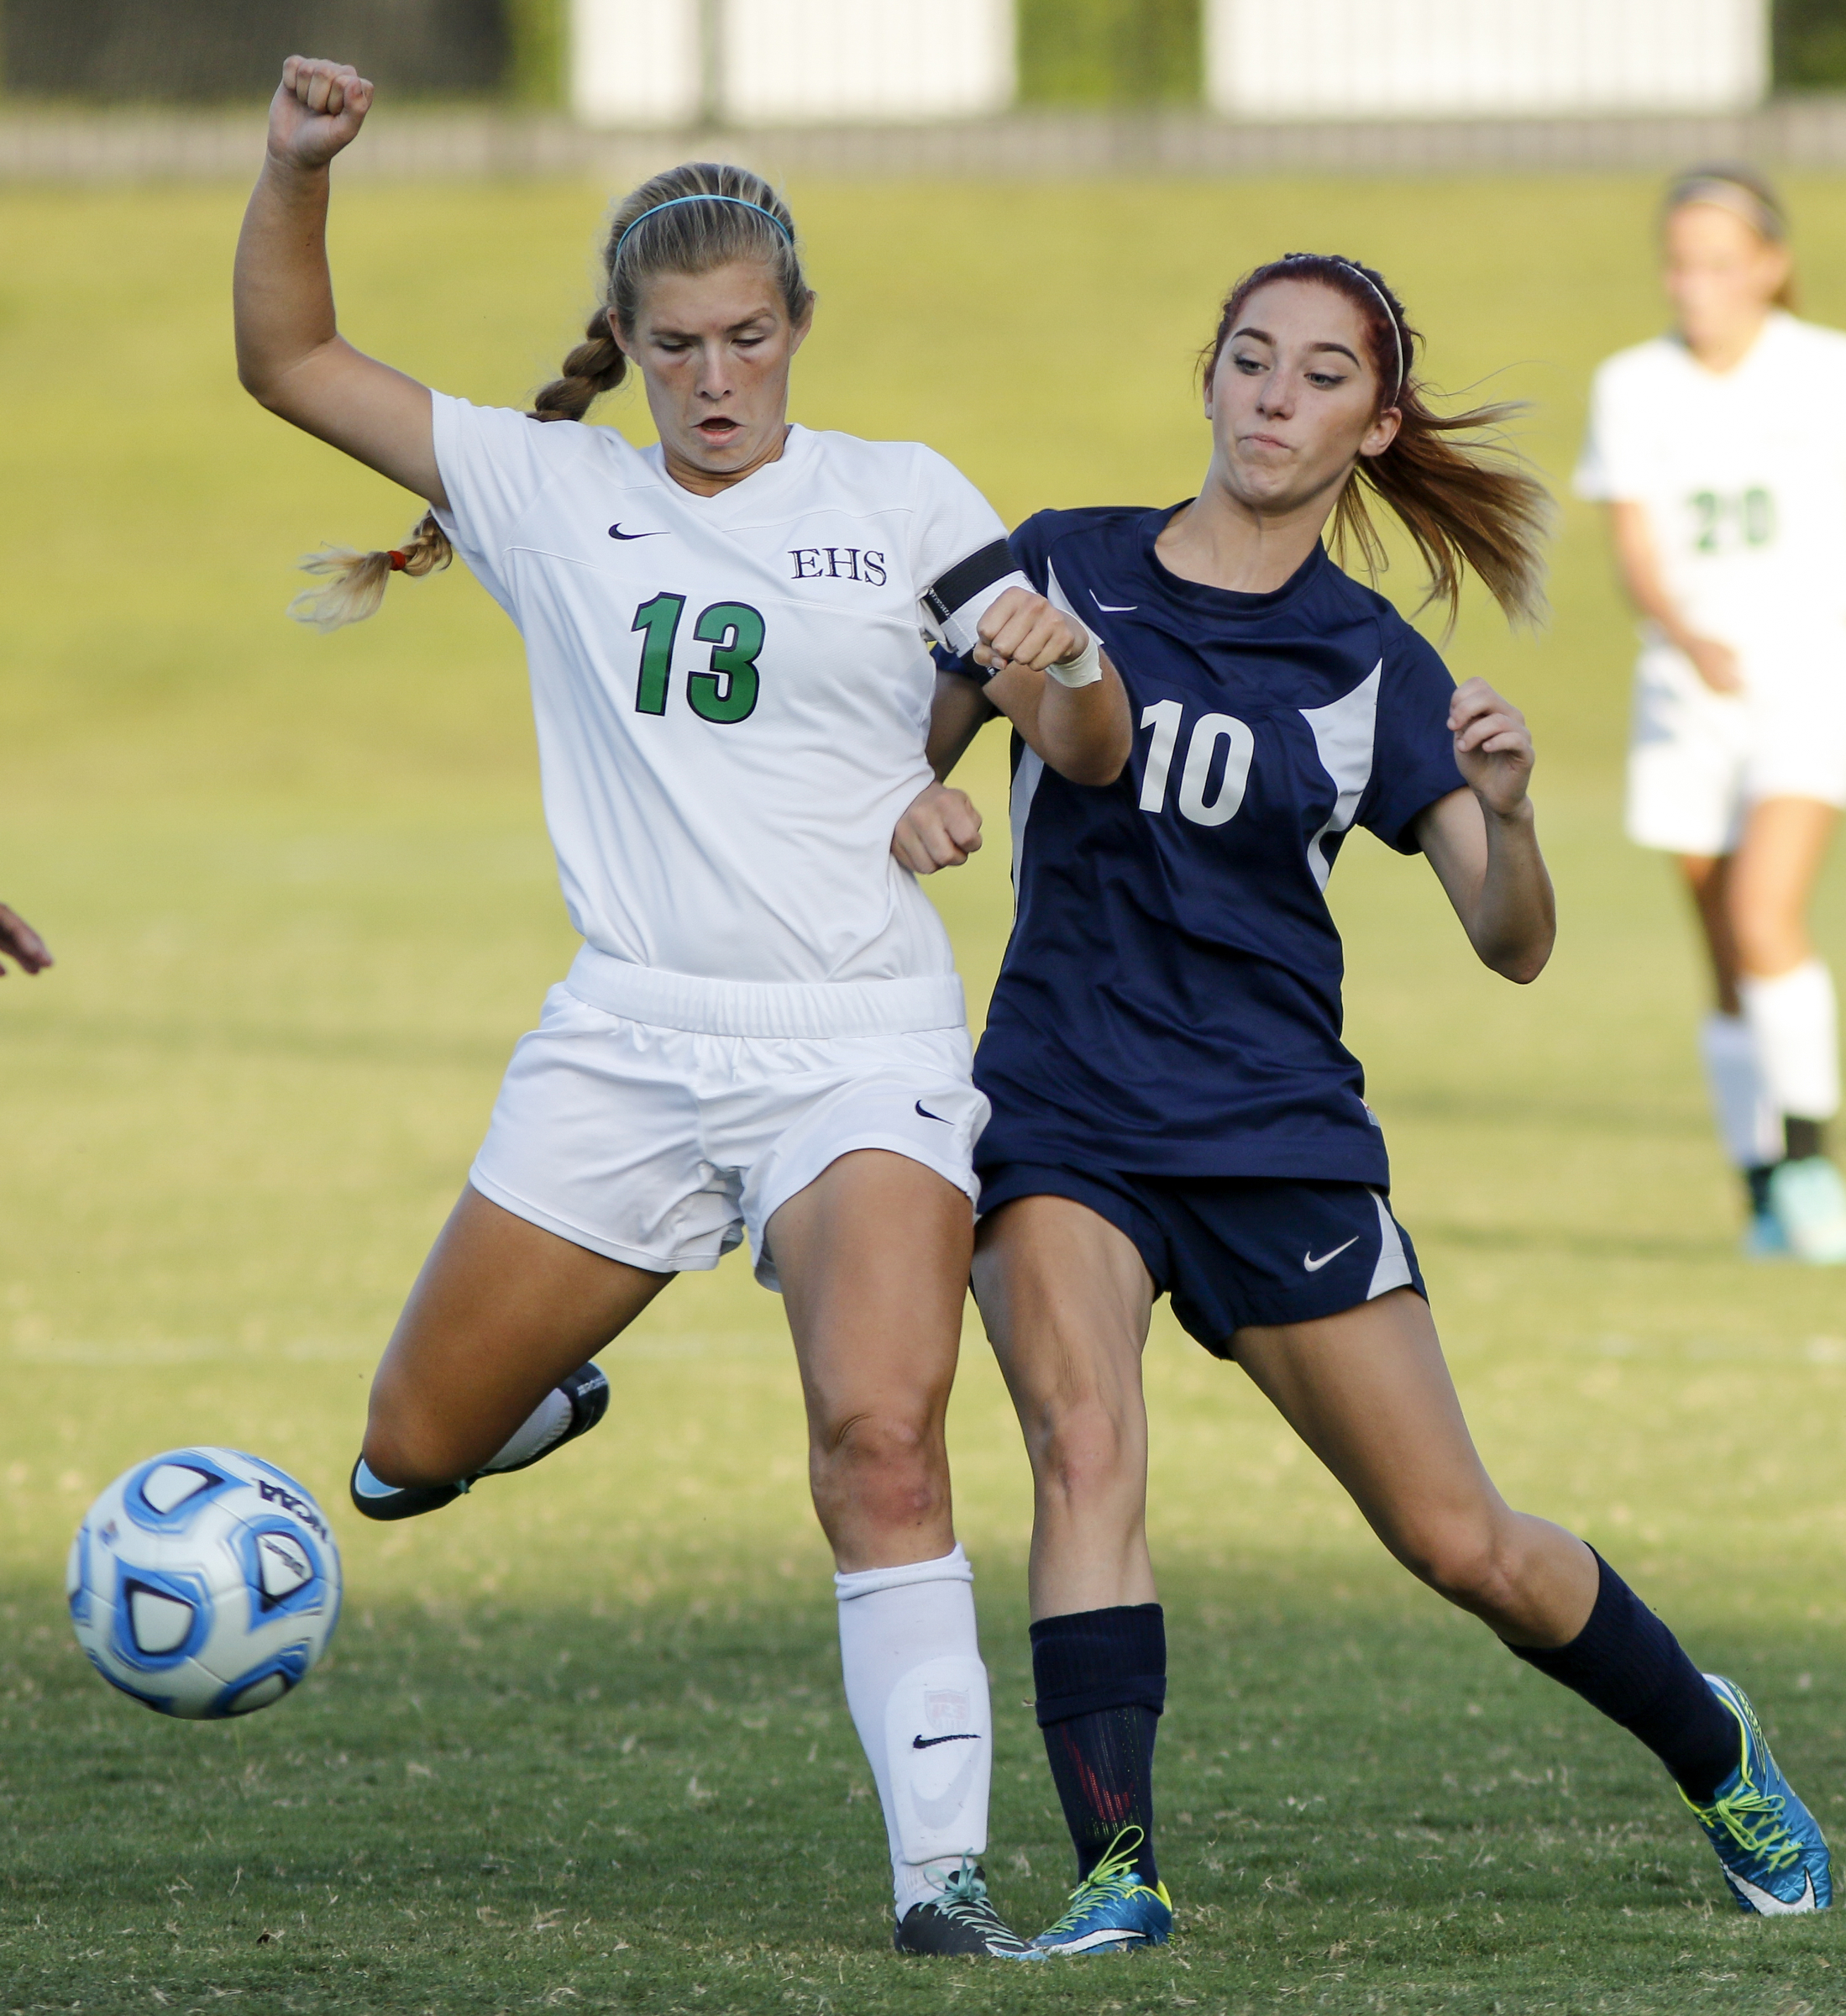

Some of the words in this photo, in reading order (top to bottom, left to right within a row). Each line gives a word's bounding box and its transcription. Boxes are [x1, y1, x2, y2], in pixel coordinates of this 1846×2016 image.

[787, 548, 887, 587] EHS
[1684, 485, 1778, 556] 20
[631, 591, 766, 725] 13
[1138, 699, 1255, 827] 10
